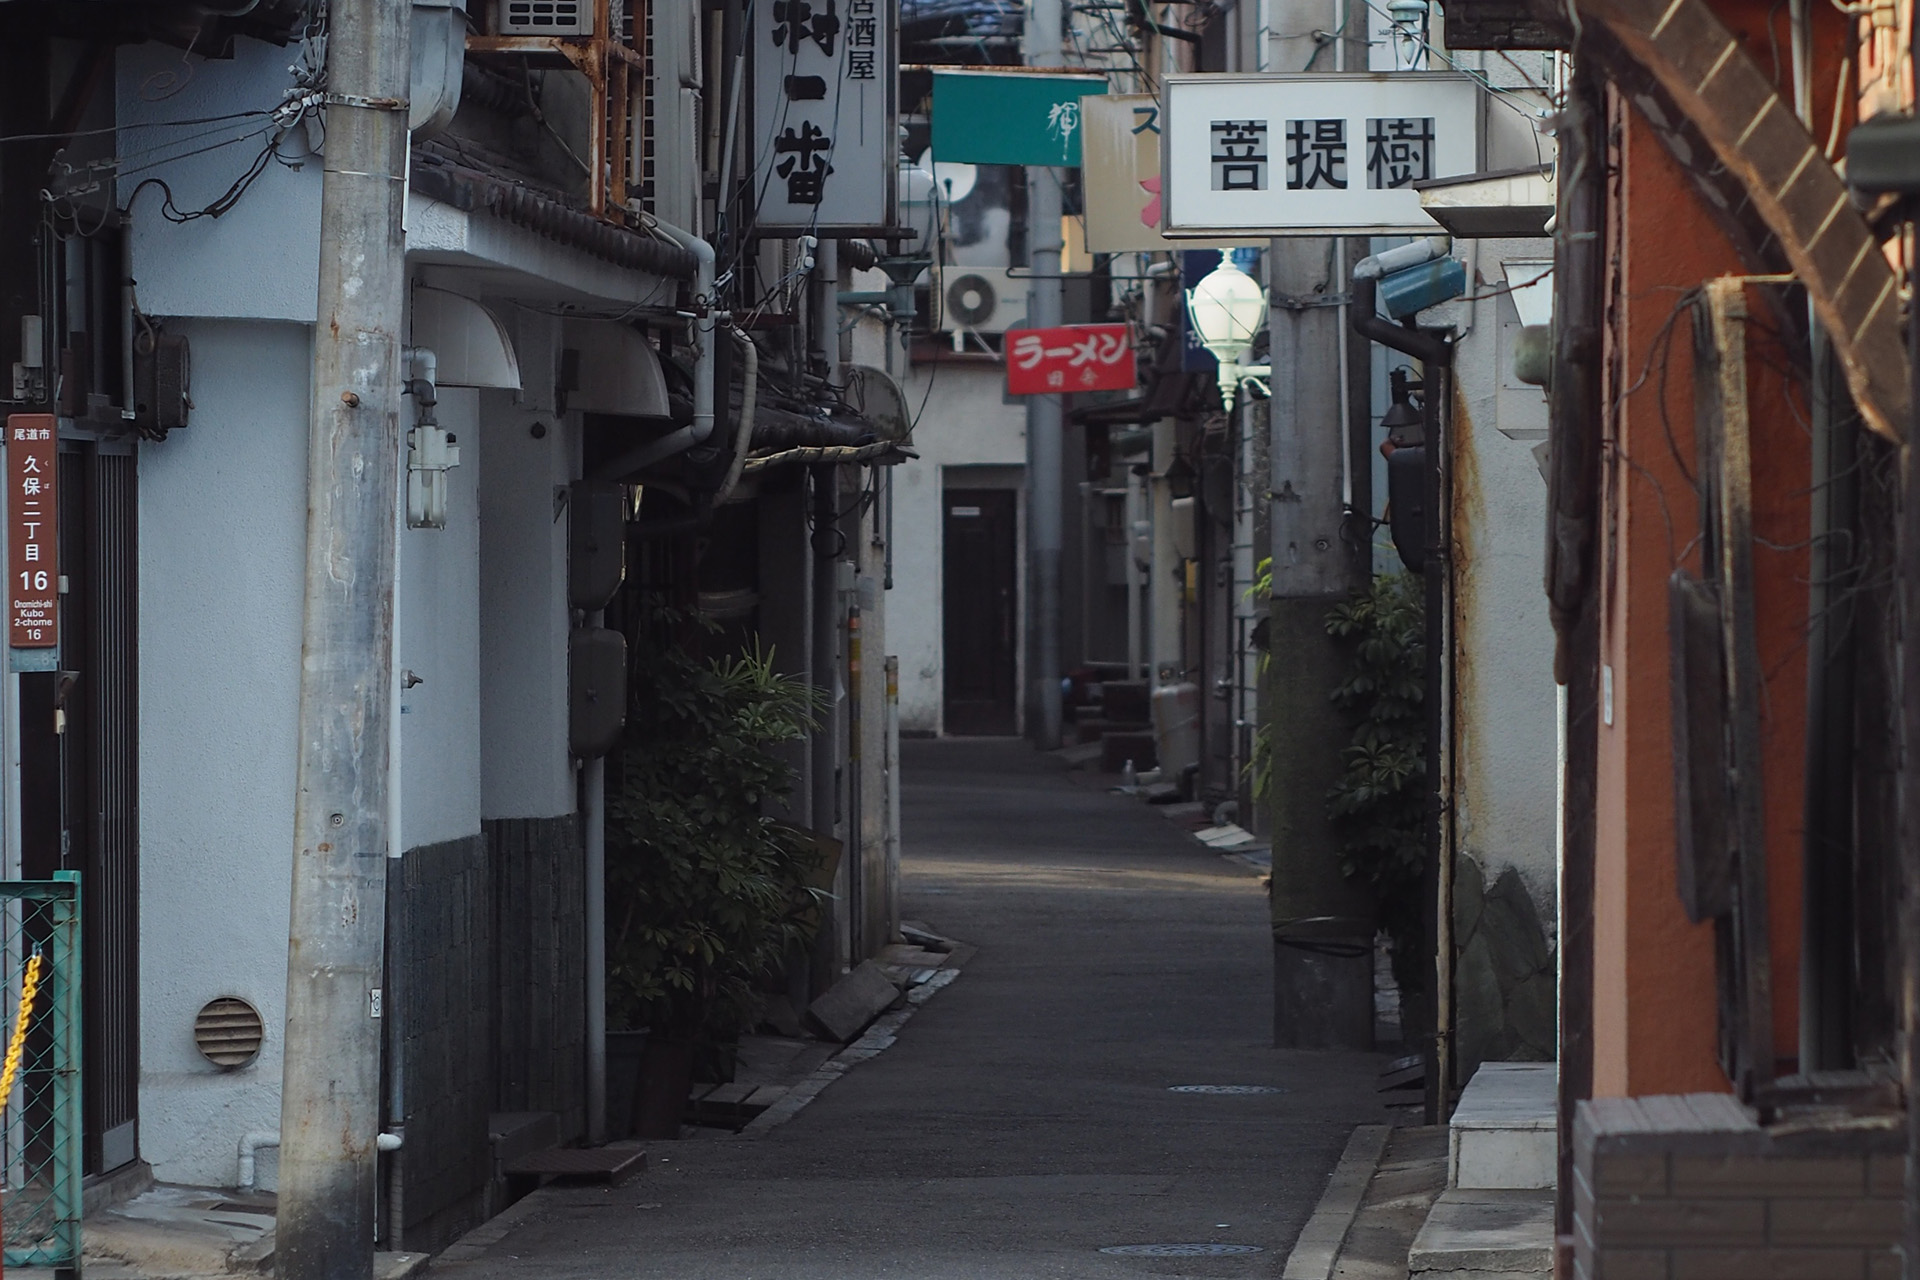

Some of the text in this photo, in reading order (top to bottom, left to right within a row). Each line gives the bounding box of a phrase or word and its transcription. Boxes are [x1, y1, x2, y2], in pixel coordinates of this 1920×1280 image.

[1211, 119, 1435, 190] 菩提樹
[1013, 333, 1129, 370] ラーメン
[14, 428, 51, 441] 尾道市
[22, 455, 42, 562] 久保二丁目
[20, 571, 48, 591] 16
[14, 600, 53, 609] Onomichi-shi
[20, 609, 45, 618] Kubo
[14, 618, 53, 627] 2-chome
[26, 629, 42, 640] 16
